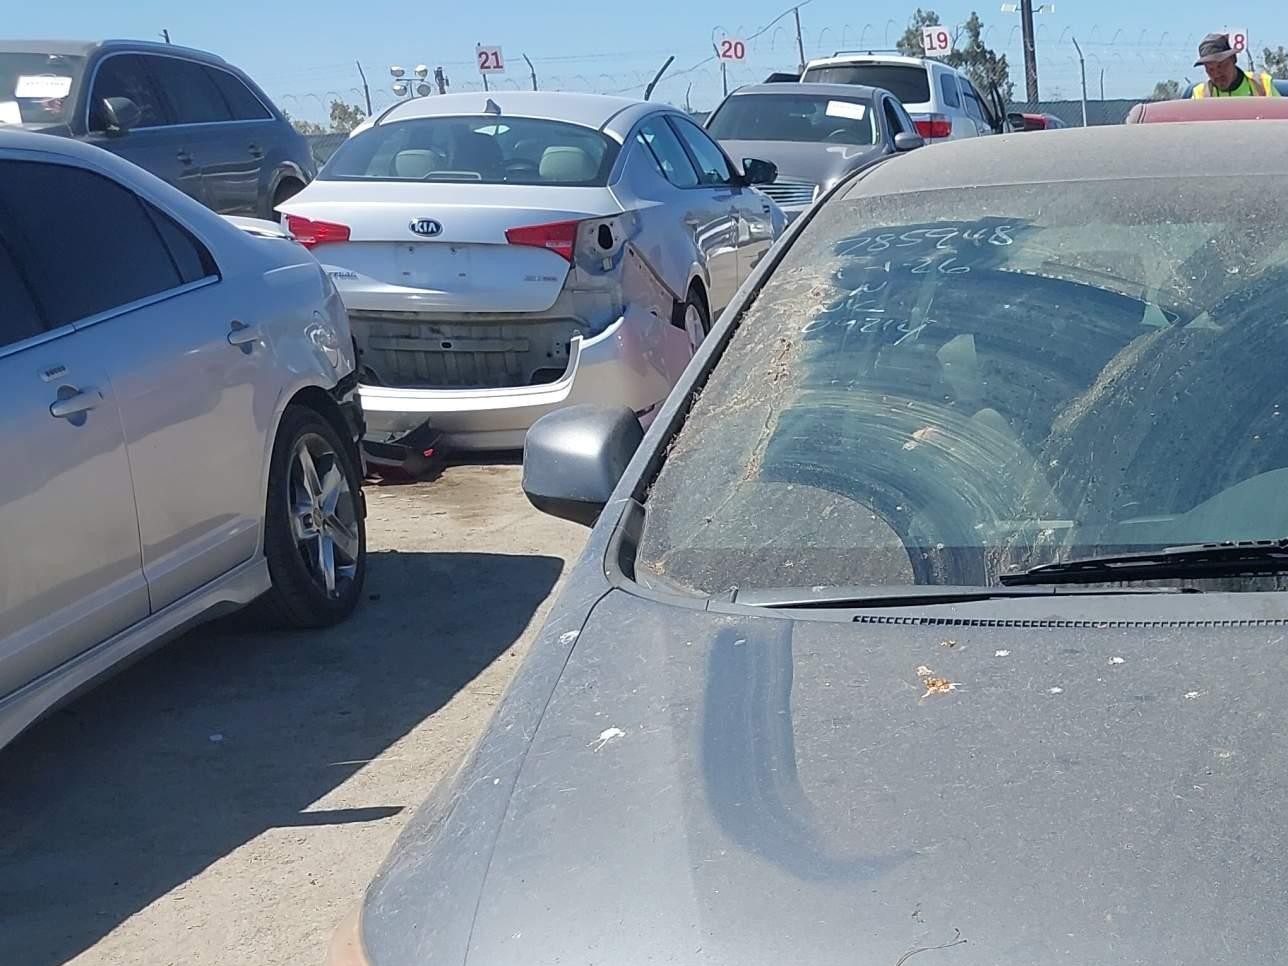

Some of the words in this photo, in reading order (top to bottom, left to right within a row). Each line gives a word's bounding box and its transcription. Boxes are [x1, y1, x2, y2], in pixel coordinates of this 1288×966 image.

[720, 40, 745, 60] 20
[925, 31, 949, 51] 19
[478, 51, 504, 70] 21
[413, 221, 438, 234] KIA
